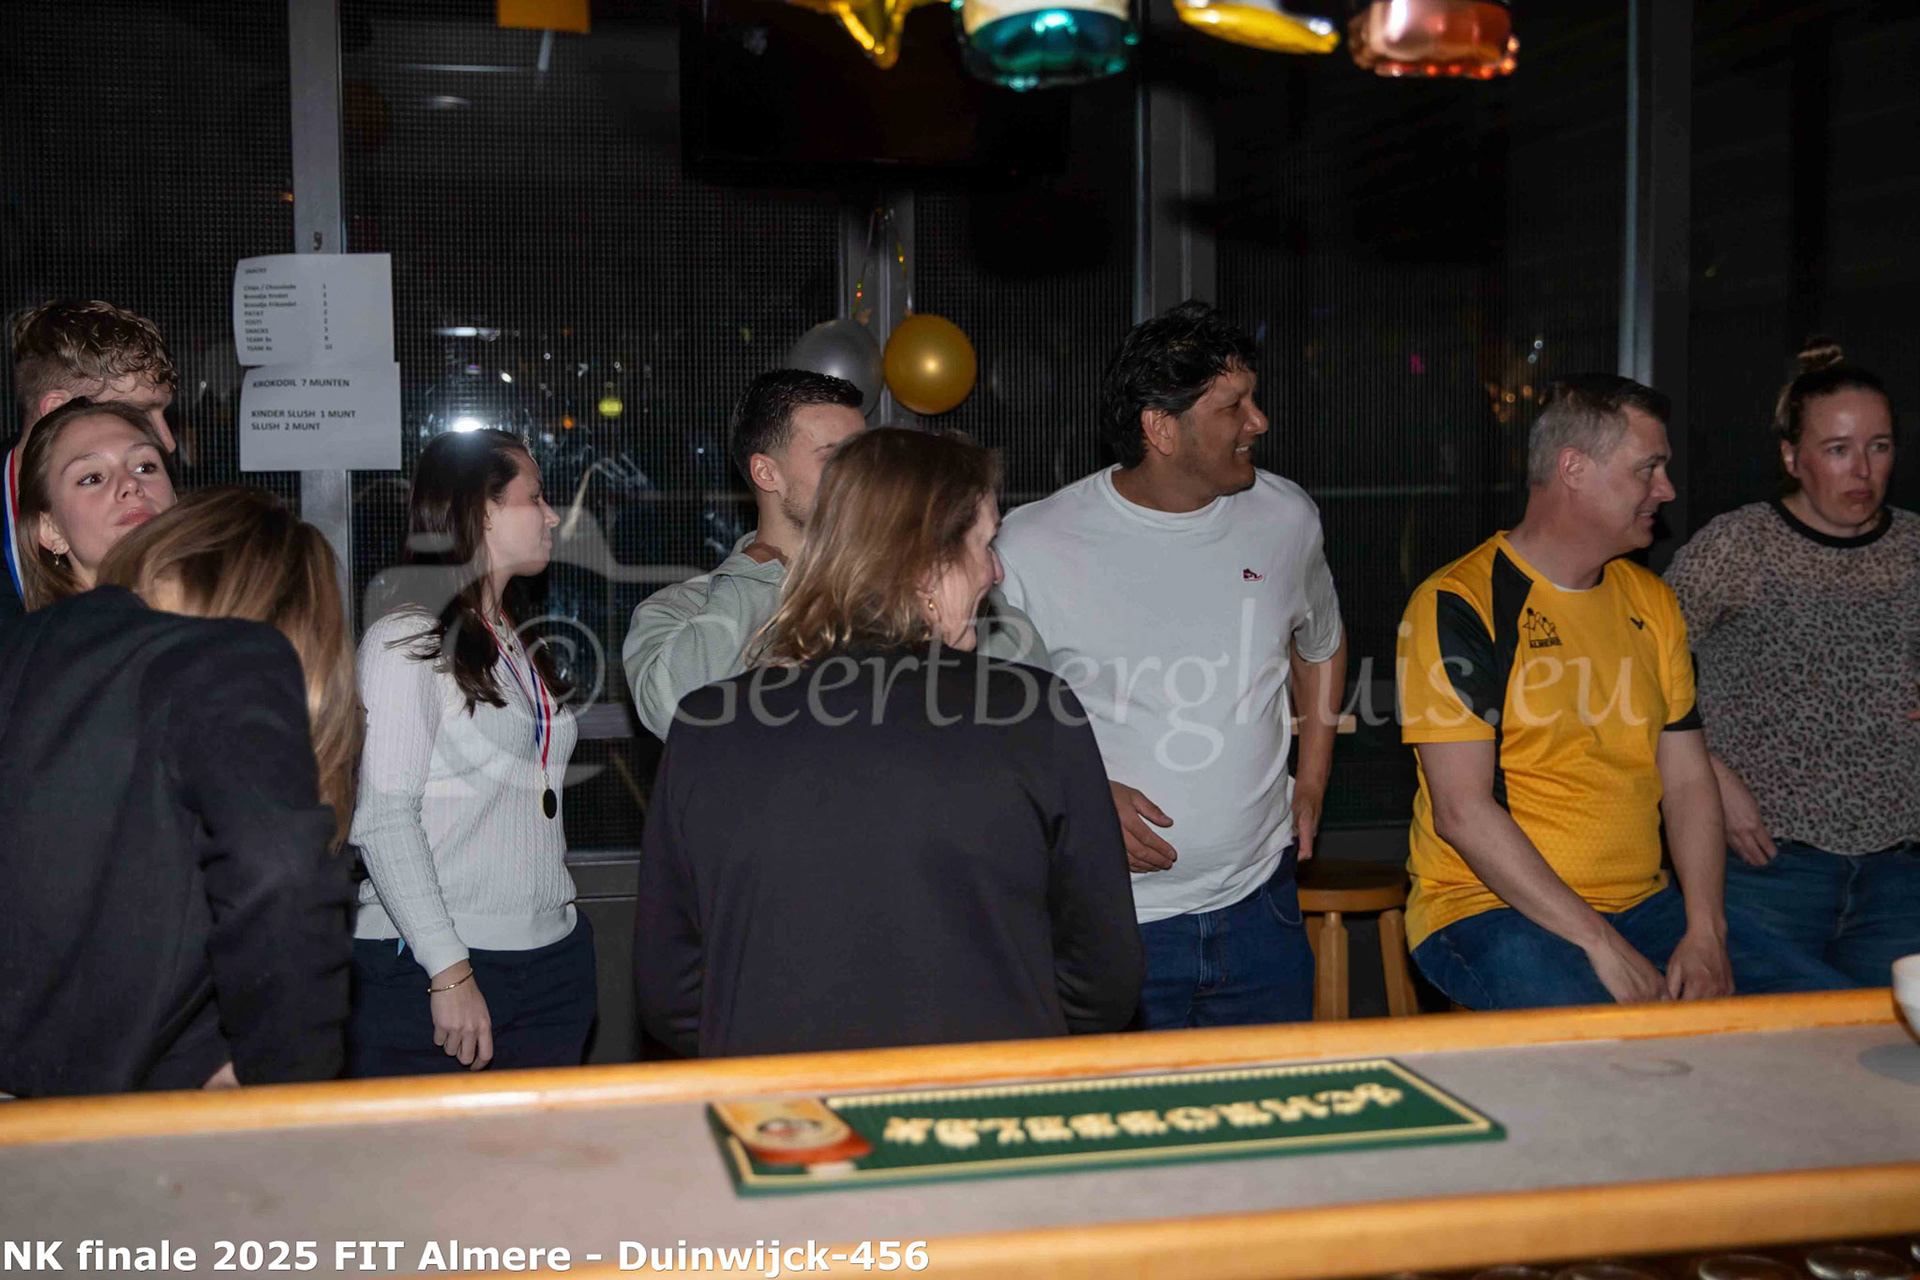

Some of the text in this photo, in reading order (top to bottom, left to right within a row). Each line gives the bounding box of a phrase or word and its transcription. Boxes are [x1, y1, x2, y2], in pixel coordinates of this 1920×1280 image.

[252, 378, 350, 388] KROKODIL 7 MUNTEN
[251, 409, 357, 418] KINDER SLUSH 1 MUNT
[251, 422, 280, 431] SLUSH
[292, 422, 321, 431] MUNT
